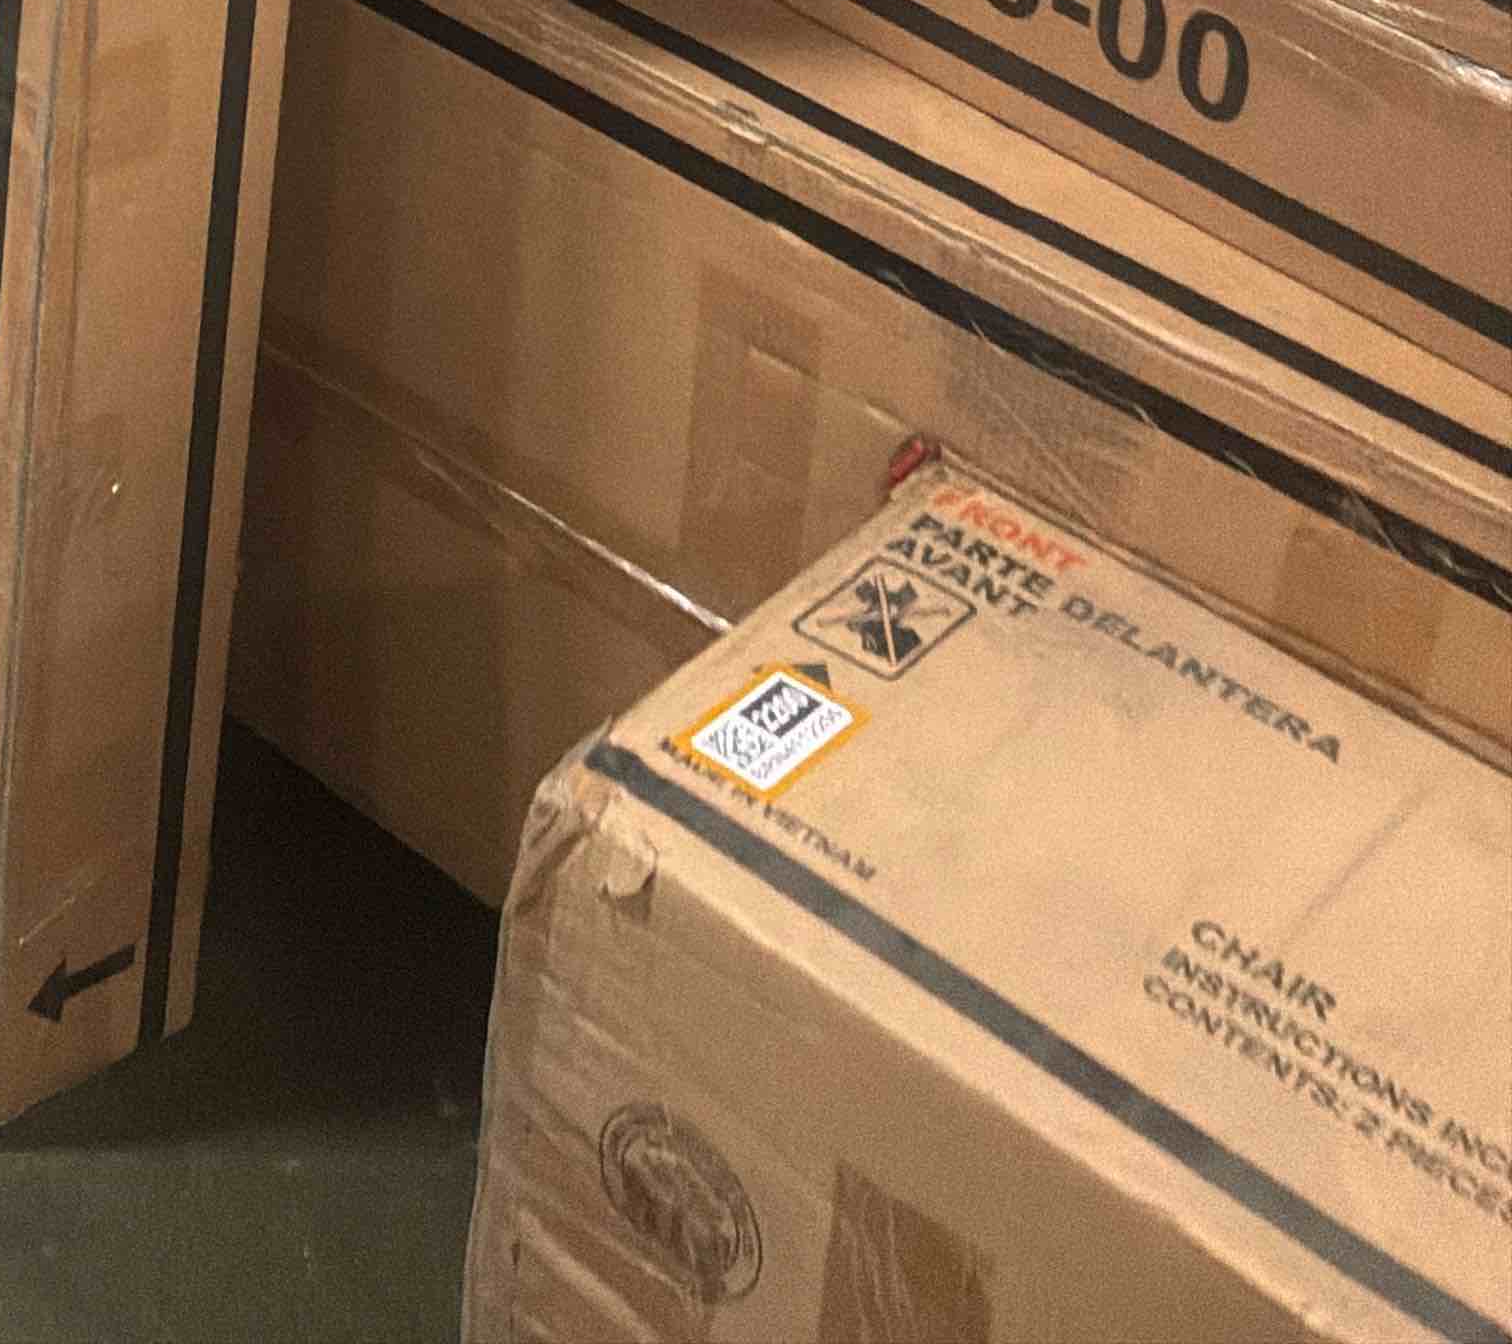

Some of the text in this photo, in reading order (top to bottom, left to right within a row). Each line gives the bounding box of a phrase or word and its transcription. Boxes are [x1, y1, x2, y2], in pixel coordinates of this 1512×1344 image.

[886, 536, 1043, 621] AVANT
[934, 487, 1088, 576] FRONT
[908, 512, 1342, 764] PARTE DELANTERA
[1190, 919, 1337, 1023] CHAIR
[1159, 944, 1433, 1127] INSTRUCTIONS
